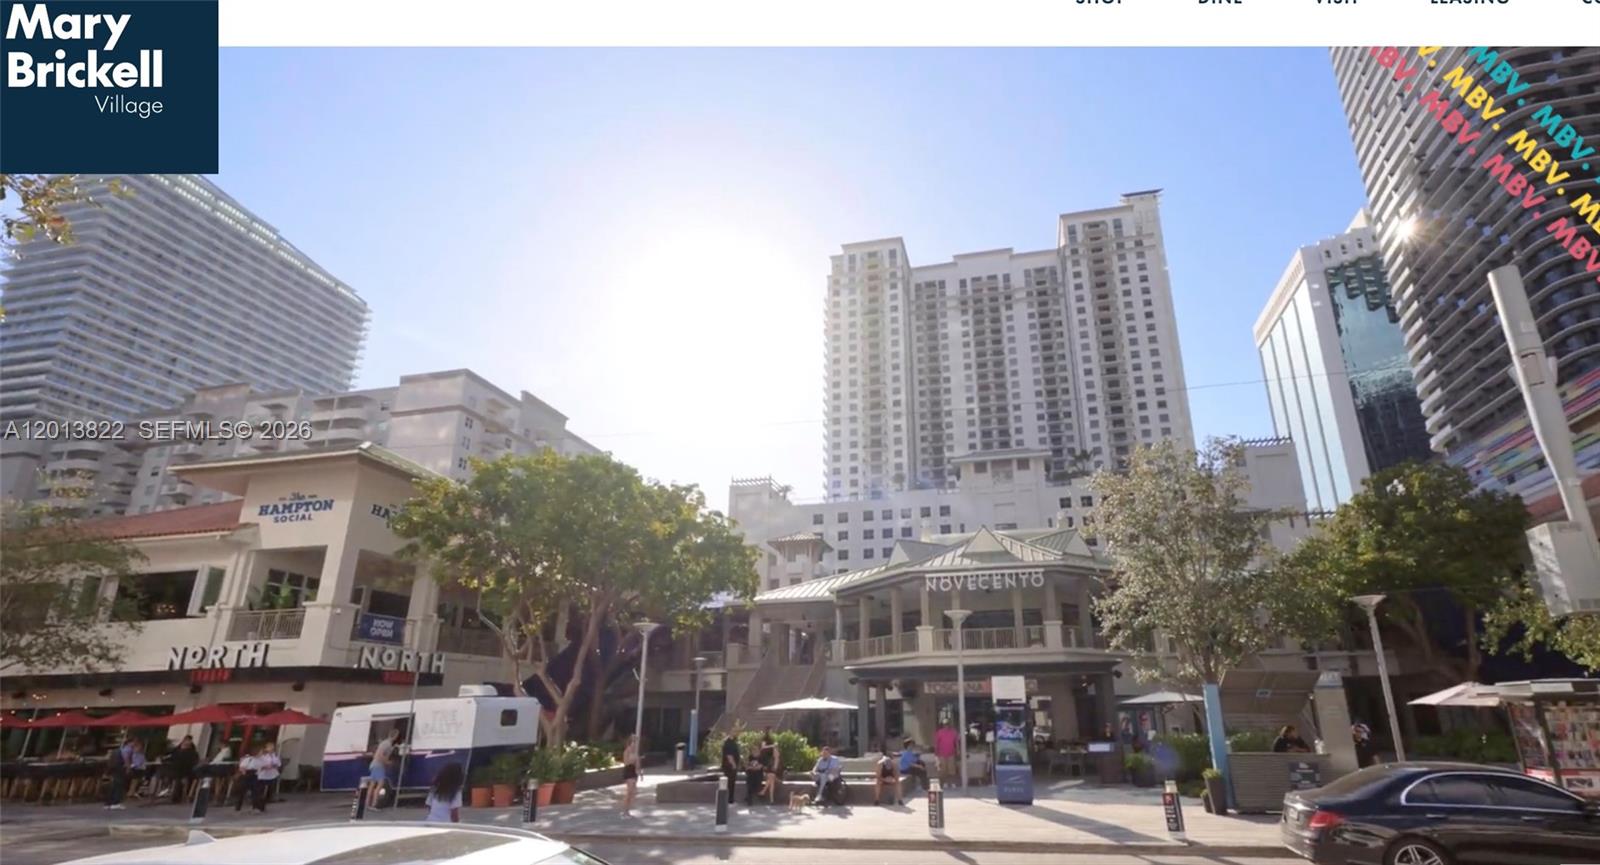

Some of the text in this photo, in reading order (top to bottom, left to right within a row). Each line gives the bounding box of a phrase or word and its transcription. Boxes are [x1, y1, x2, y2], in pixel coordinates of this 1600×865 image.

[258, 499, 334, 516] HAMPTON
[273, 513, 313, 523] SOCIAL
[925, 573, 1045, 591] NOVECENTO
[167, 643, 270, 670] NORTH
[361, 647, 446, 673] NORTH
